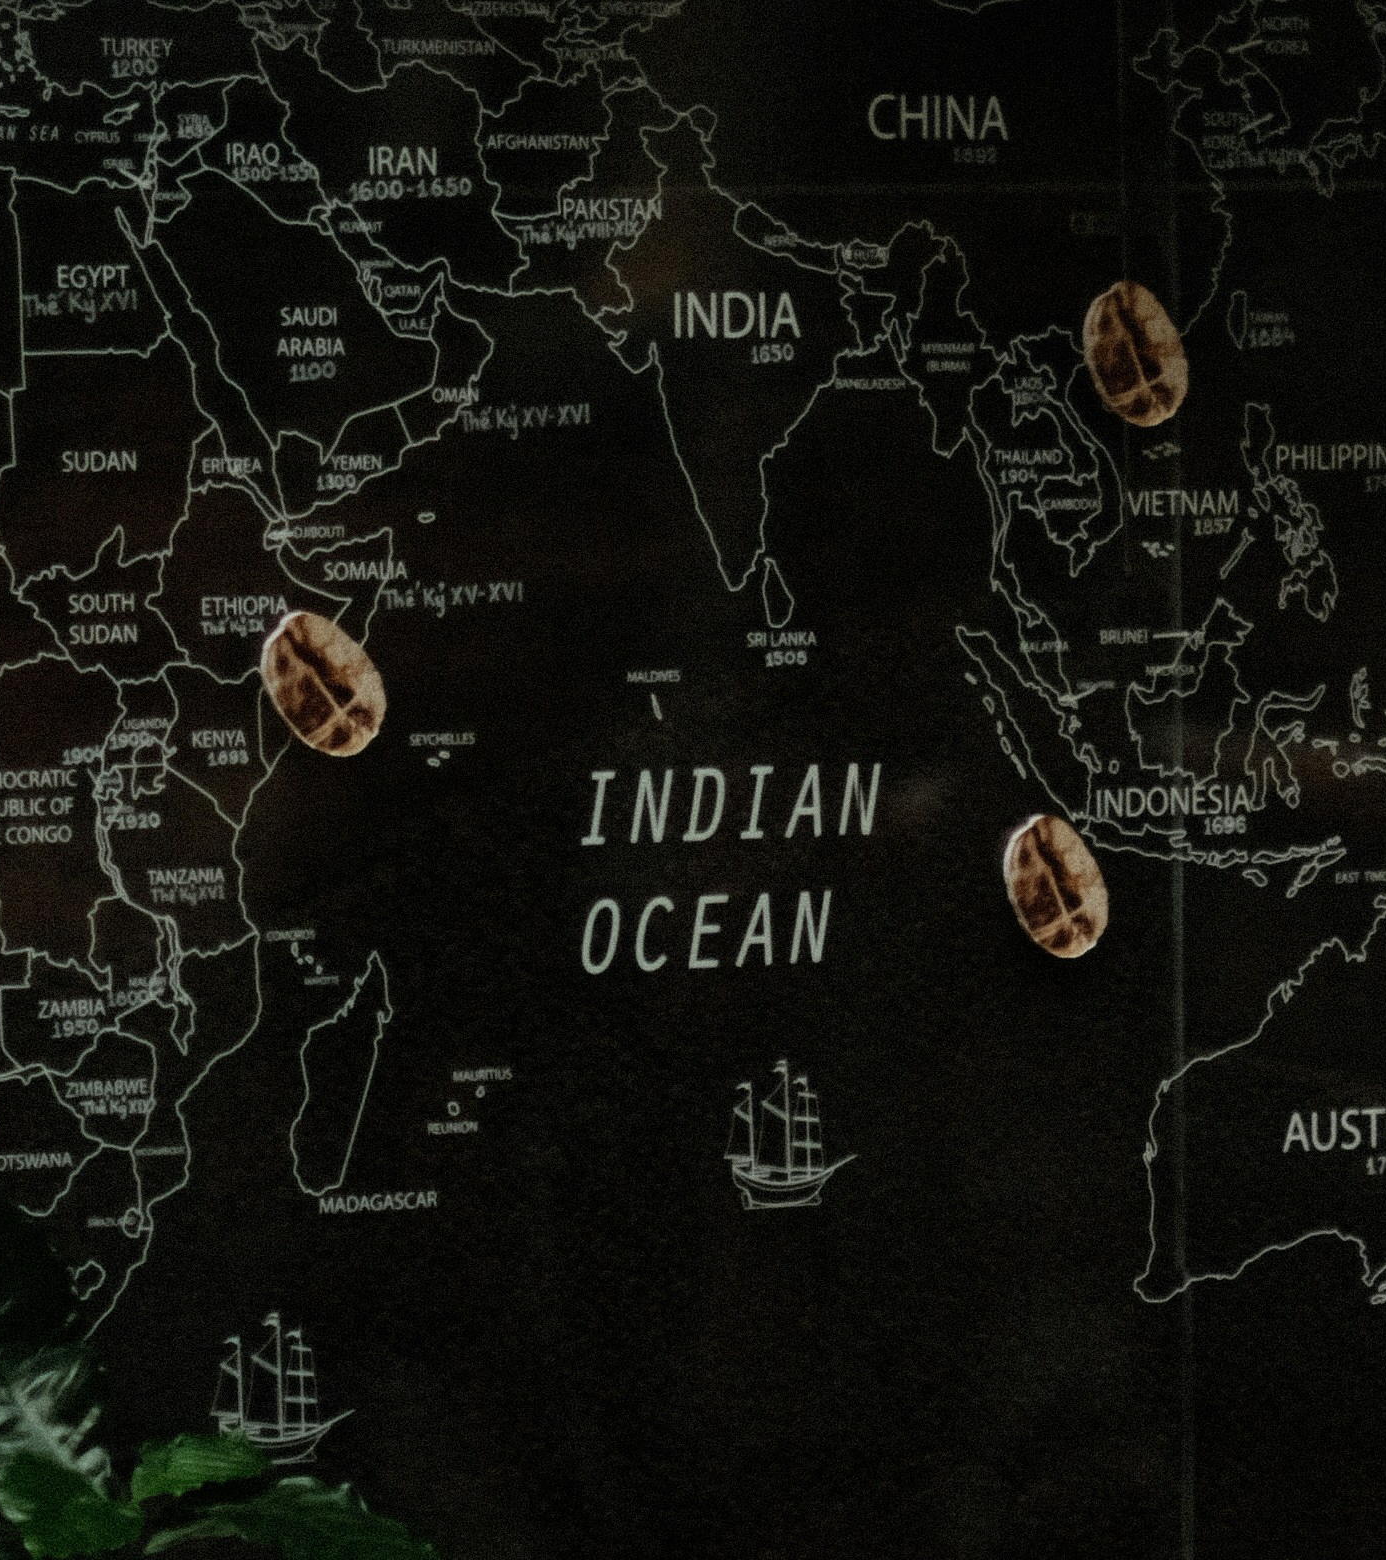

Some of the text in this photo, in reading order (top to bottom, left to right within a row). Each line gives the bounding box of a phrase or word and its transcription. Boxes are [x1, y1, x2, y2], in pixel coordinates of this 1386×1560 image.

[1263, 16, 1311, 32] NORTH
[101, 38, 173, 58] TURKEY
[1265, 39, 1311, 55] KOREA
[866, 92, 1010, 142] CHINA
[29, 125, 60, 141] SEA
[74, 129, 121, 144] CYPRUS
[485, 134, 593, 152] AFGHANISTAN
[225, 142, 281, 167] IRAQ
[367, 146, 438, 178] IRAN
[348, 176, 473, 201] 1600-1650
[560, 197, 664, 222] PAKISTAN
[56, 264, 131, 288] EGYPT
[382, 283, 422, 299] QATAR
[279, 306, 339, 327] SAUDI
[672, 290, 802, 340] INDIA
[276, 337, 346, 358] ARABIA
[750, 344, 796, 365] 1650
[289, 360, 338, 382] 1100
[431, 386, 481, 403] OMAN
[834, 377, 907, 391] BANGLADESH
[60, 450, 138, 474] SUDAN
[201, 457, 263, 475] ERITREA
[330, 454, 383, 471] YEMEN
[994, 448, 1064, 466] THAILAND
[1127, 489, 1240, 518] VIETNAM
[1193, 516, 1236, 537] 1857
[322, 561, 409, 582] SOMALIA
[68, 593, 136, 613] SOUTH
[201, 596, 289, 618] ETHIOPIA
[68, 624, 138, 645] SUDAN
[746, 630, 818, 648] SRI LANKA
[1099, 628, 1149, 646] BRUNEI
[191, 729, 247, 749] KENYA
[49, 795, 75, 817] OF
[580, 762, 882, 847] INDIAN
[1095, 783, 1253, 819] INDONESIA
[4, 823, 73, 846] CONGO
[148, 867, 225, 886] TANZANIA
[580, 889, 832, 975] OCEAN
[37, 999, 106, 1019] ZAMBIA
[64, 1077, 149, 1098] ZIMBABWE
[318, 1190, 438, 1214] MADAGASCAR
